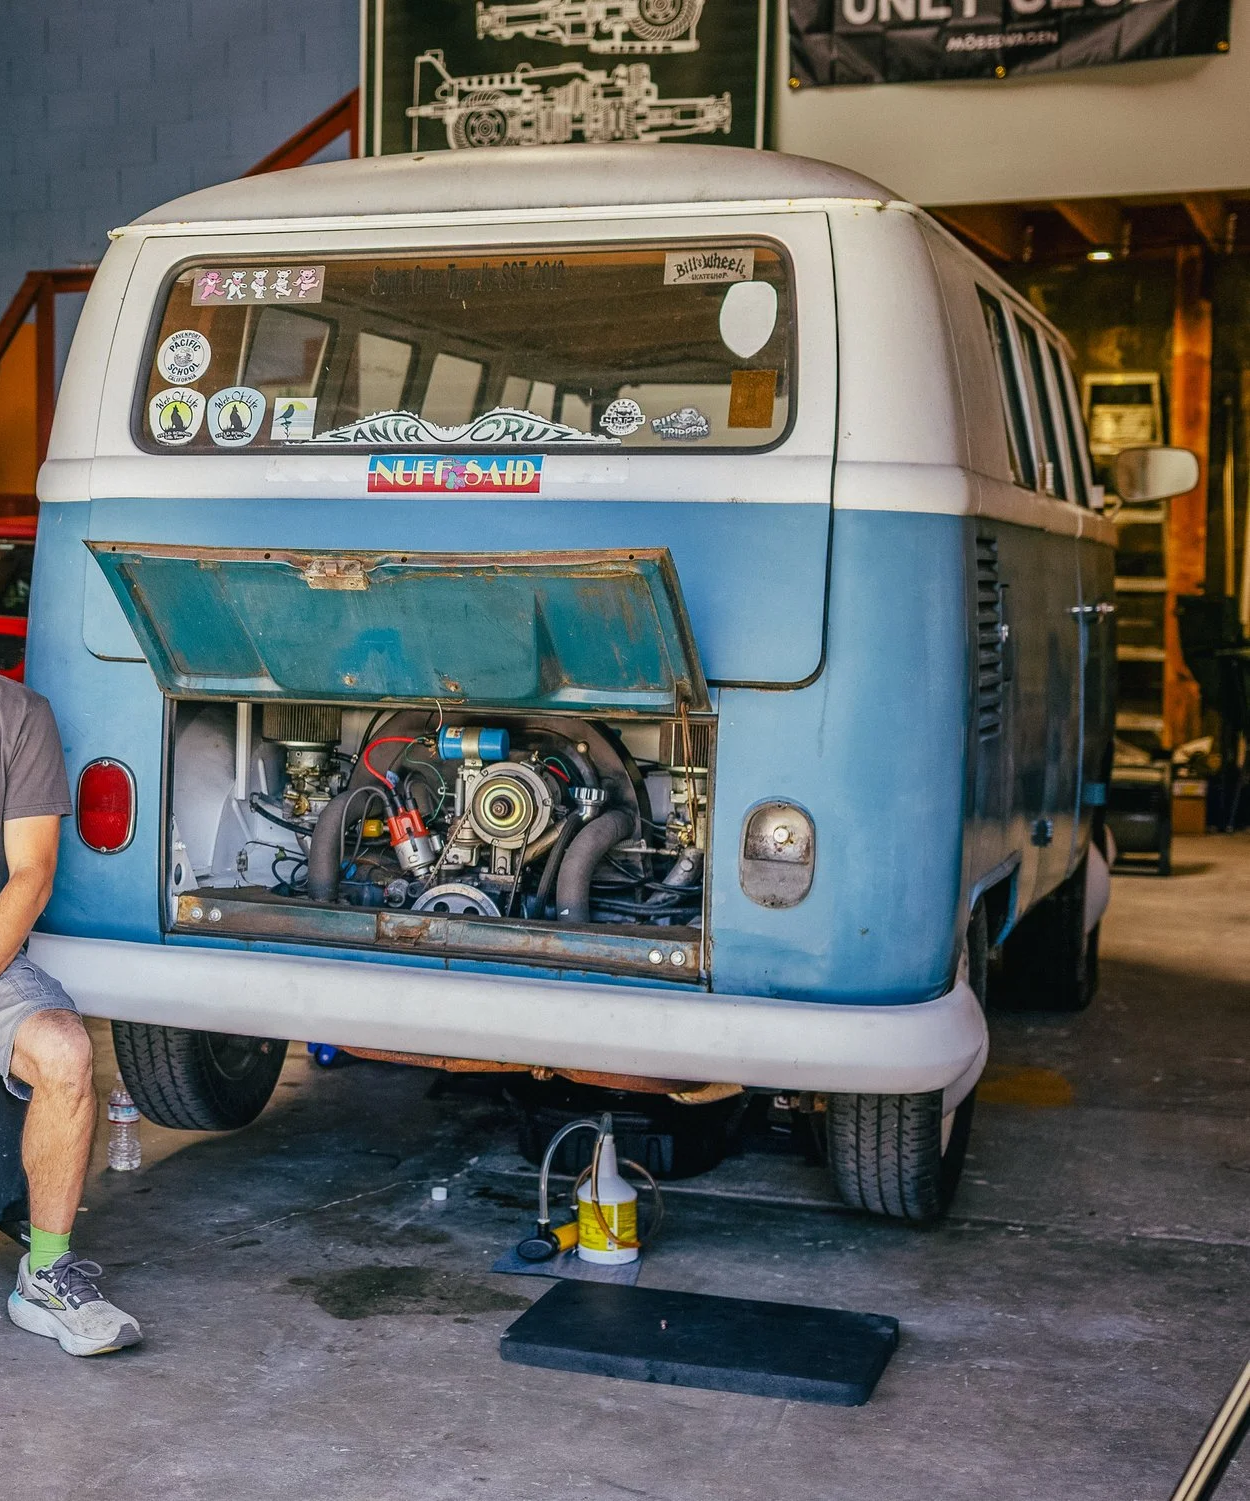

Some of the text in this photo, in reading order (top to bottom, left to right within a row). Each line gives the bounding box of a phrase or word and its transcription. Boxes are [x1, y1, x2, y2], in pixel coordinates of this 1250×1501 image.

[701, 252, 746, 275] Wheels
[171, 332, 201, 342] DAVENPORT
[169, 338, 201, 352] PACIFIC
[167, 362, 200, 376] SCHOOL
[167, 373, 197, 383] CALIFORNIA
[652, 413, 678, 430] BUS
[329, 417, 580, 443] SANTA CRUZ
[660, 425, 709, 437] TRIPPERS
[374, 459, 535, 486] NUFF SAID
